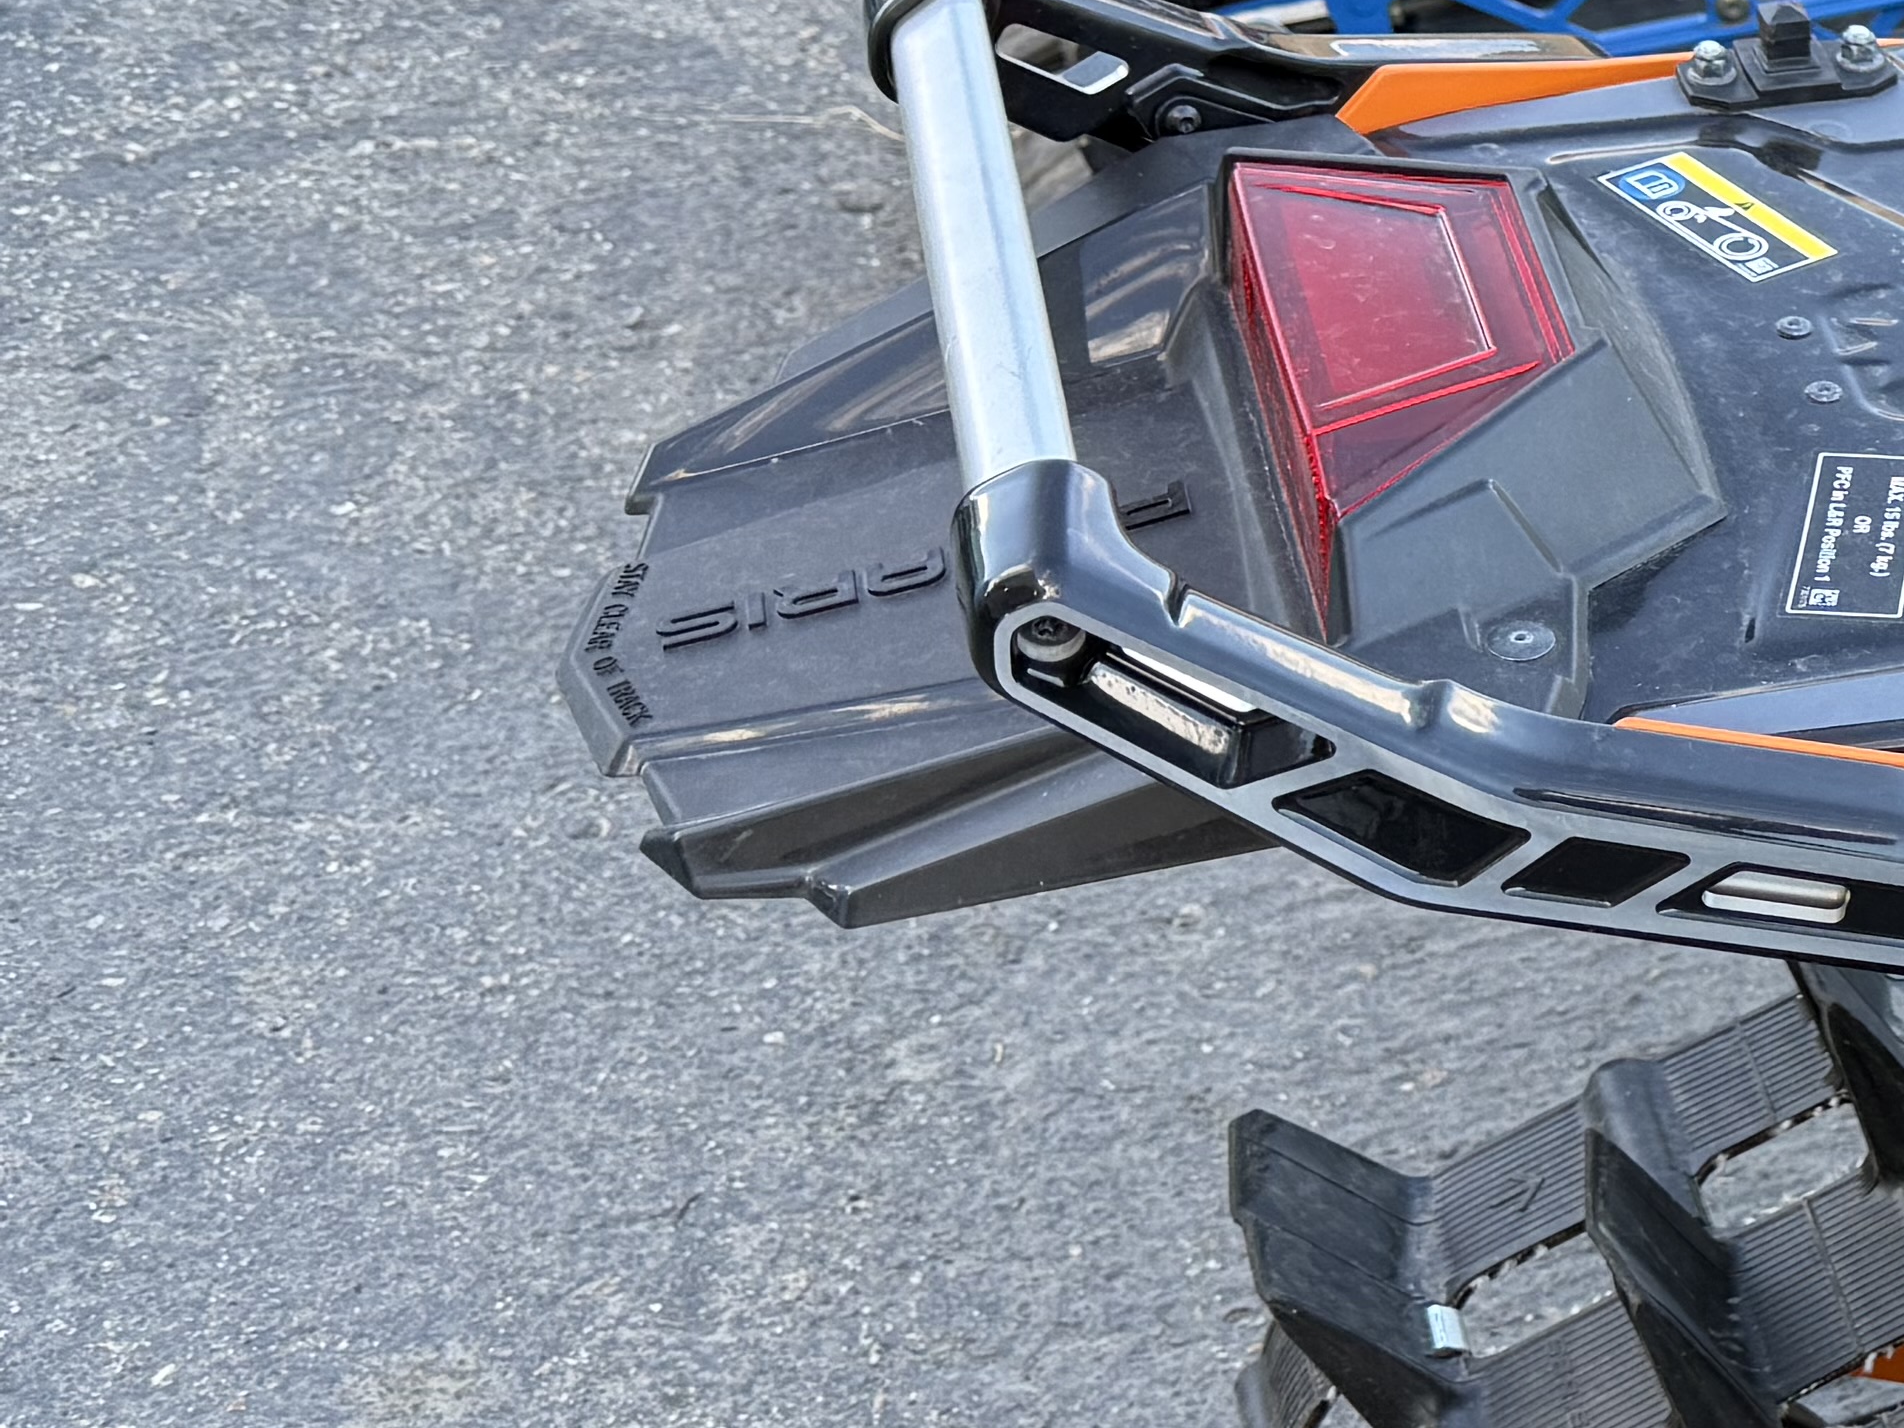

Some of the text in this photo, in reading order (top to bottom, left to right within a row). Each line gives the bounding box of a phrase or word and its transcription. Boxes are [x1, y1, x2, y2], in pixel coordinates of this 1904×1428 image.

[1833, 466, 1854, 490] PFC
[1825, 502, 1847, 527] L&R
[1852, 515, 1873, 534] OR
[1884, 507, 1902, 520] 15
[1880, 521, 1900, 541] lbs.
[1815, 527, 1842, 574] Position
[1875, 542, 1895, 555] (7
[656, 480, 1192, 652] PARIS
[1814, 574, 1831, 582] 1
[584, 561, 654, 729] STAY CLEAR OF TRACK
